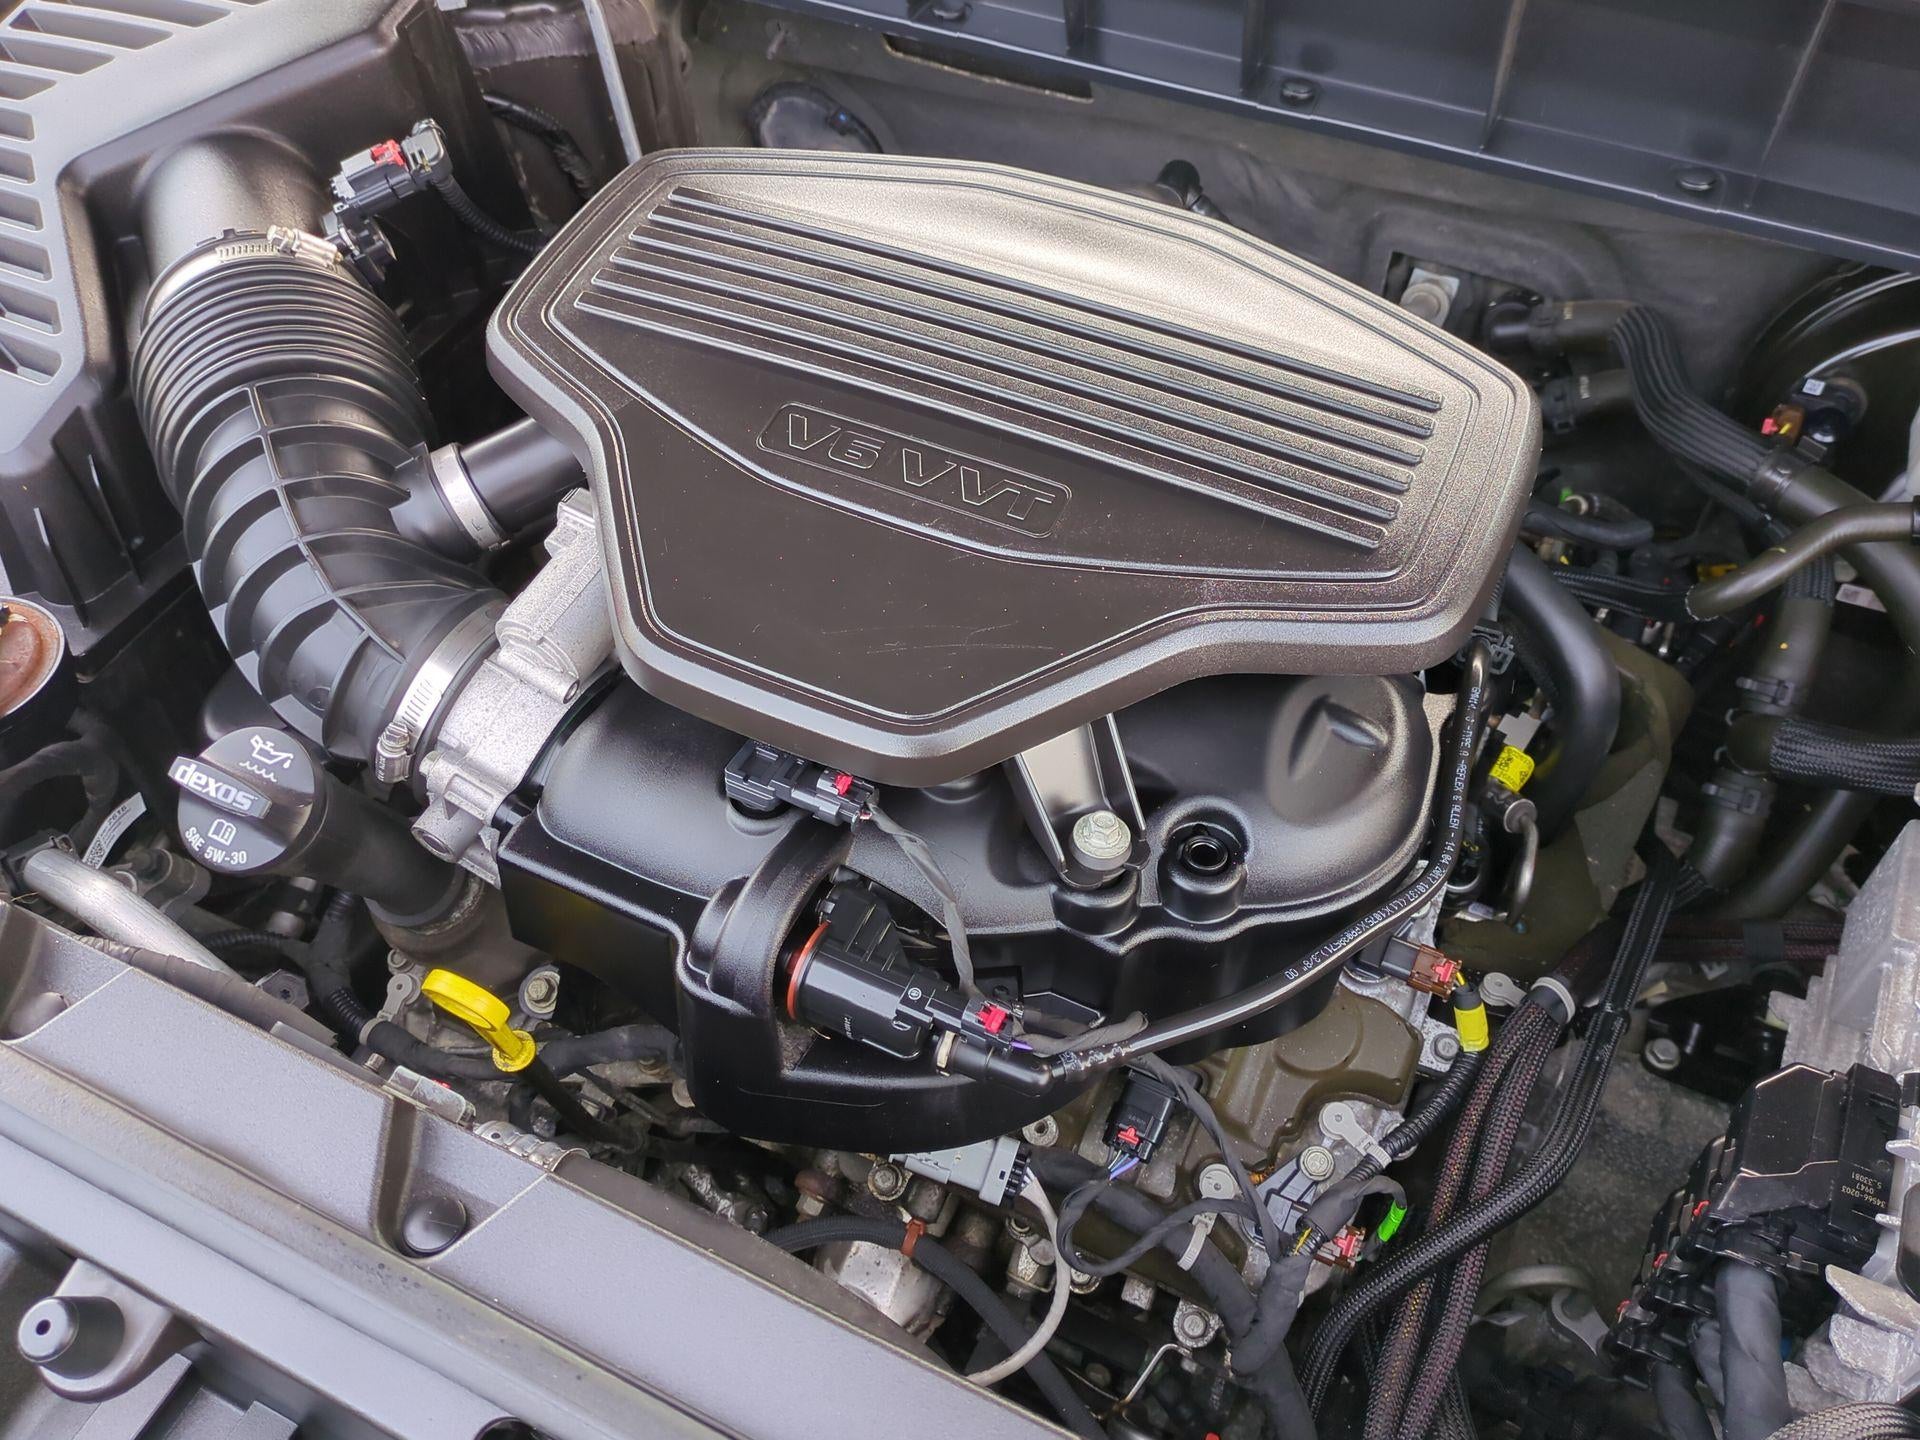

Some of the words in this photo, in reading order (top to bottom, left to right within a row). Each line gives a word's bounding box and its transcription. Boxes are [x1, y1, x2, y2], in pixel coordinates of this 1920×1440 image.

[788, 413, 887, 469] V6
[902, 447, 1056, 521] VVT
[174, 763, 257, 812] dexos
[185, 826, 206, 852] SAE
[203, 846, 248, 865] 5W-30
